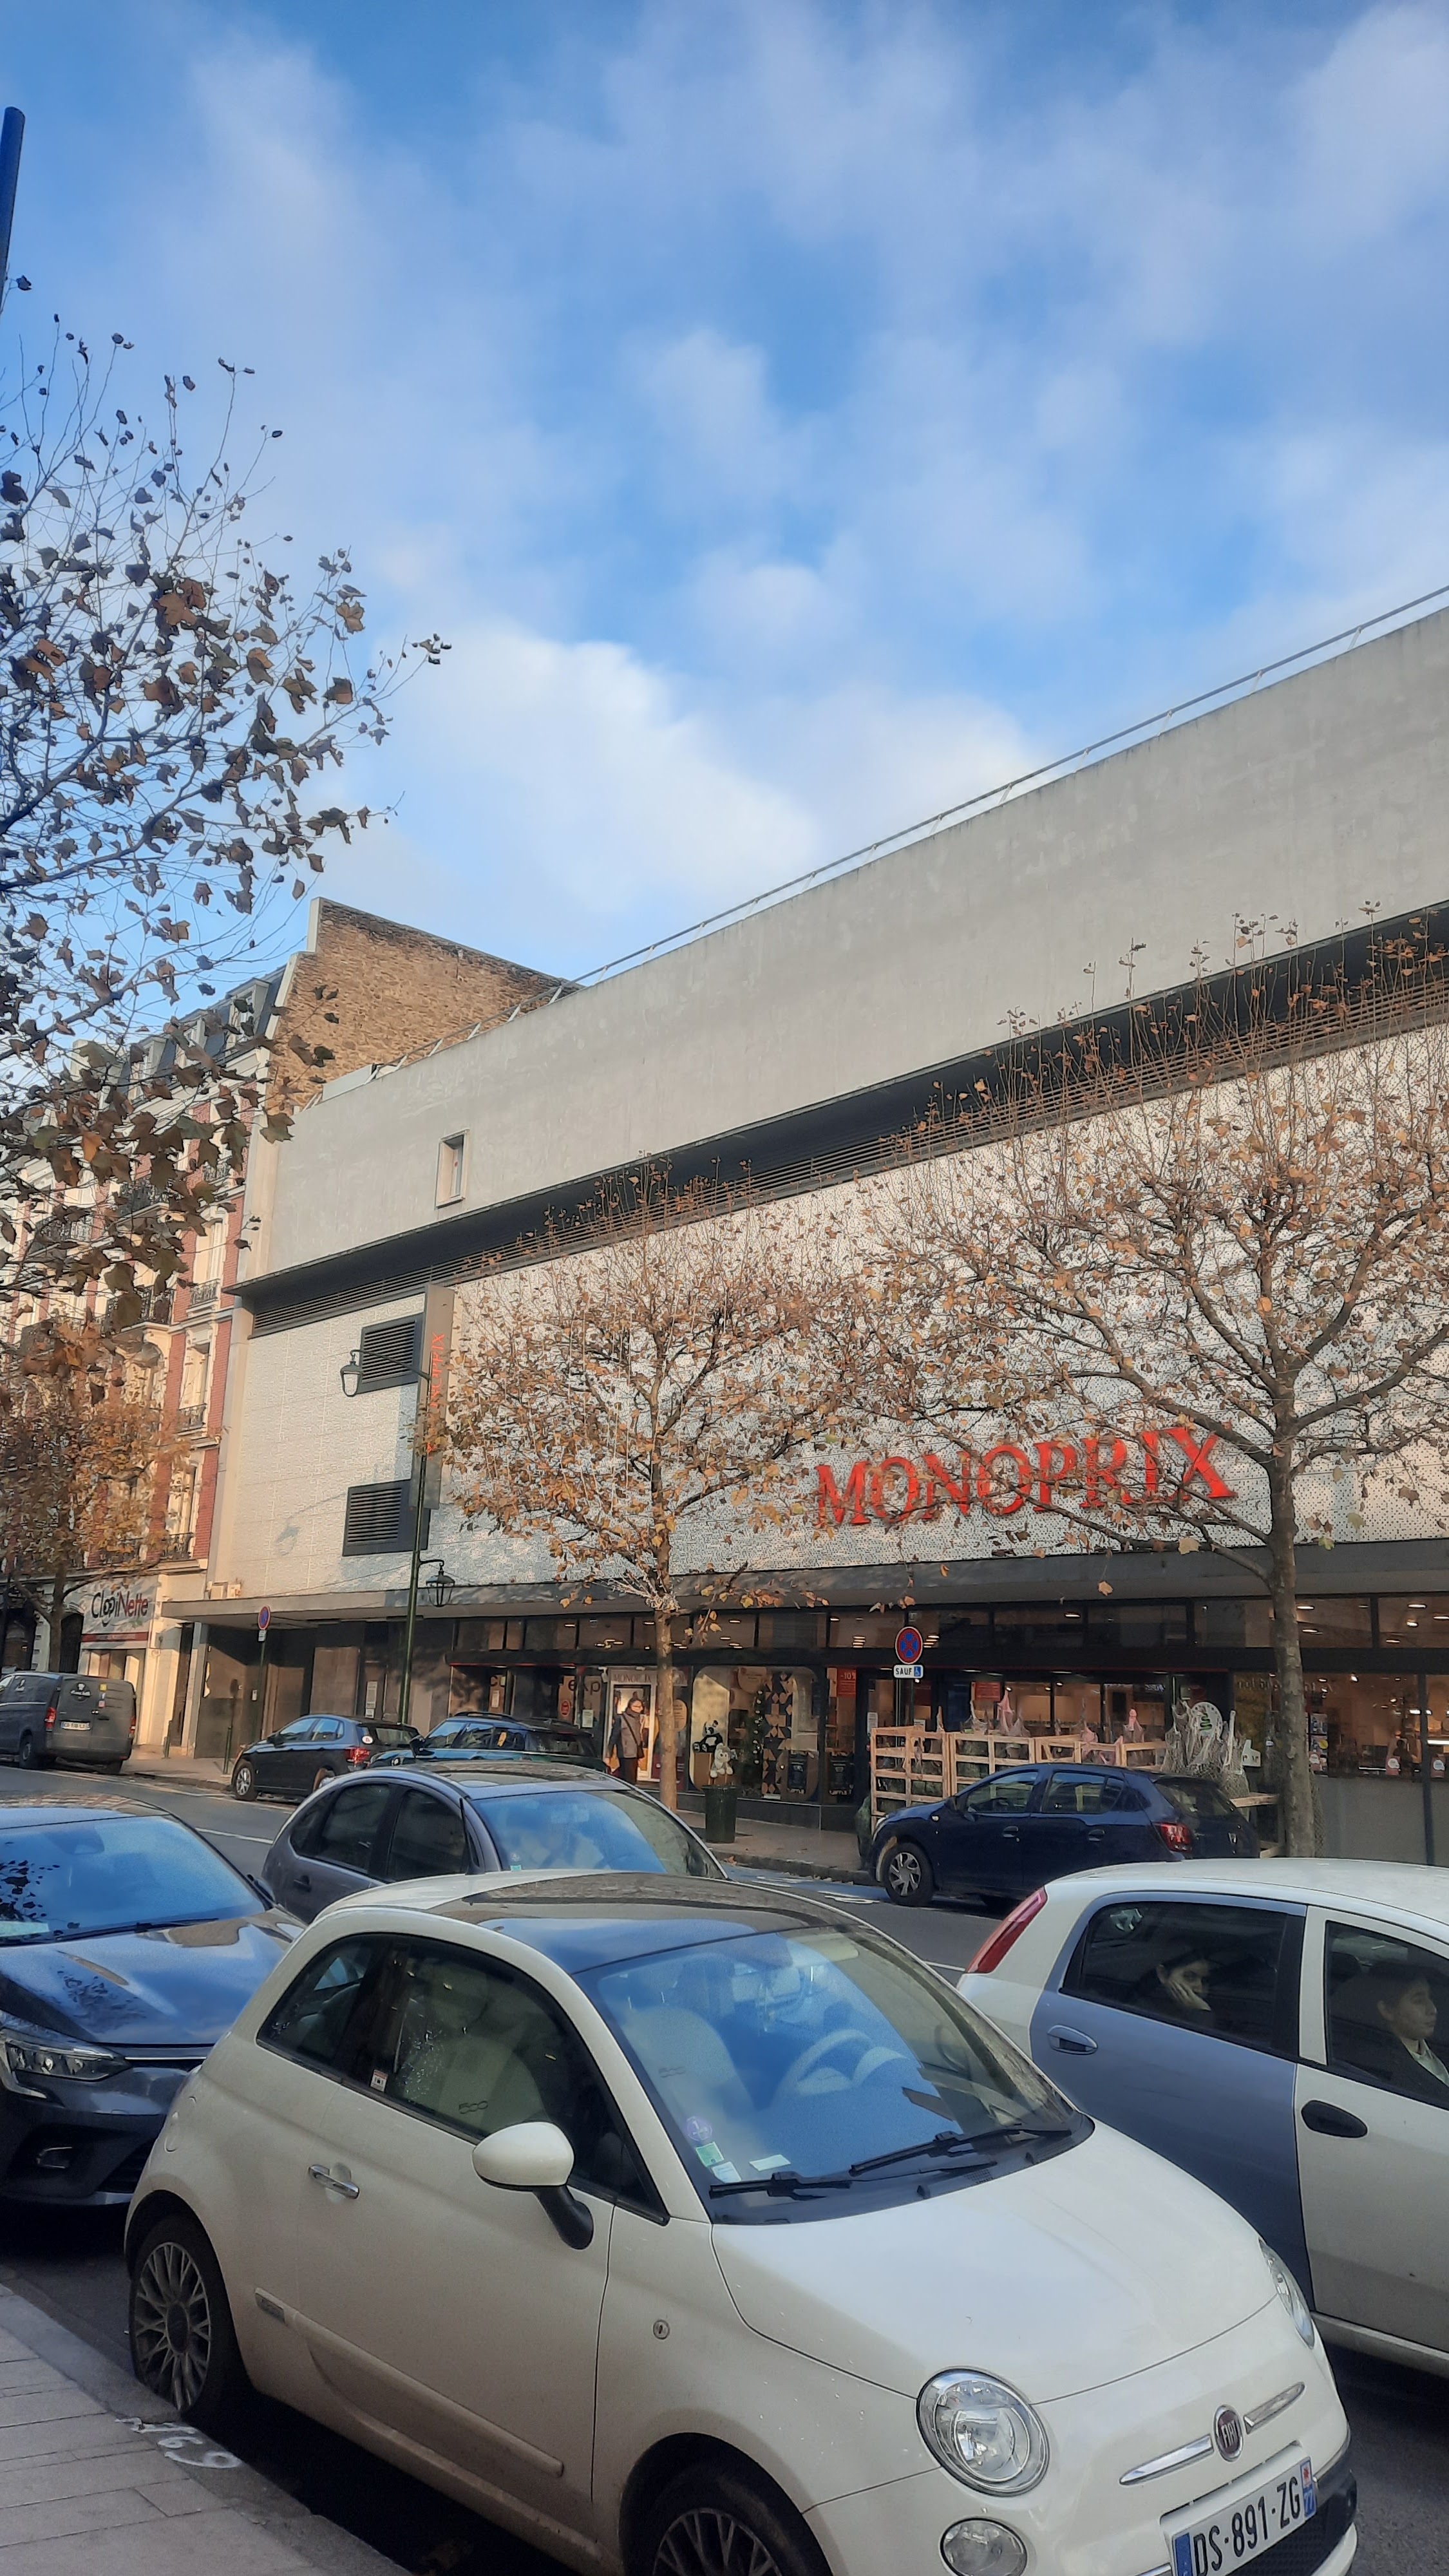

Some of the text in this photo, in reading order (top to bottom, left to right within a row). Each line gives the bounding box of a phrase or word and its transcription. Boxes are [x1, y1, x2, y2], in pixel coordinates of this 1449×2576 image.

[814, 1426, 1238, 1525] MONOPRIX
[459, 2101, 488, 2114] 500
[1220, 2420, 1238, 2448] FIAT
[1193, 2476, 1301, 2576] DS-891-ZG
